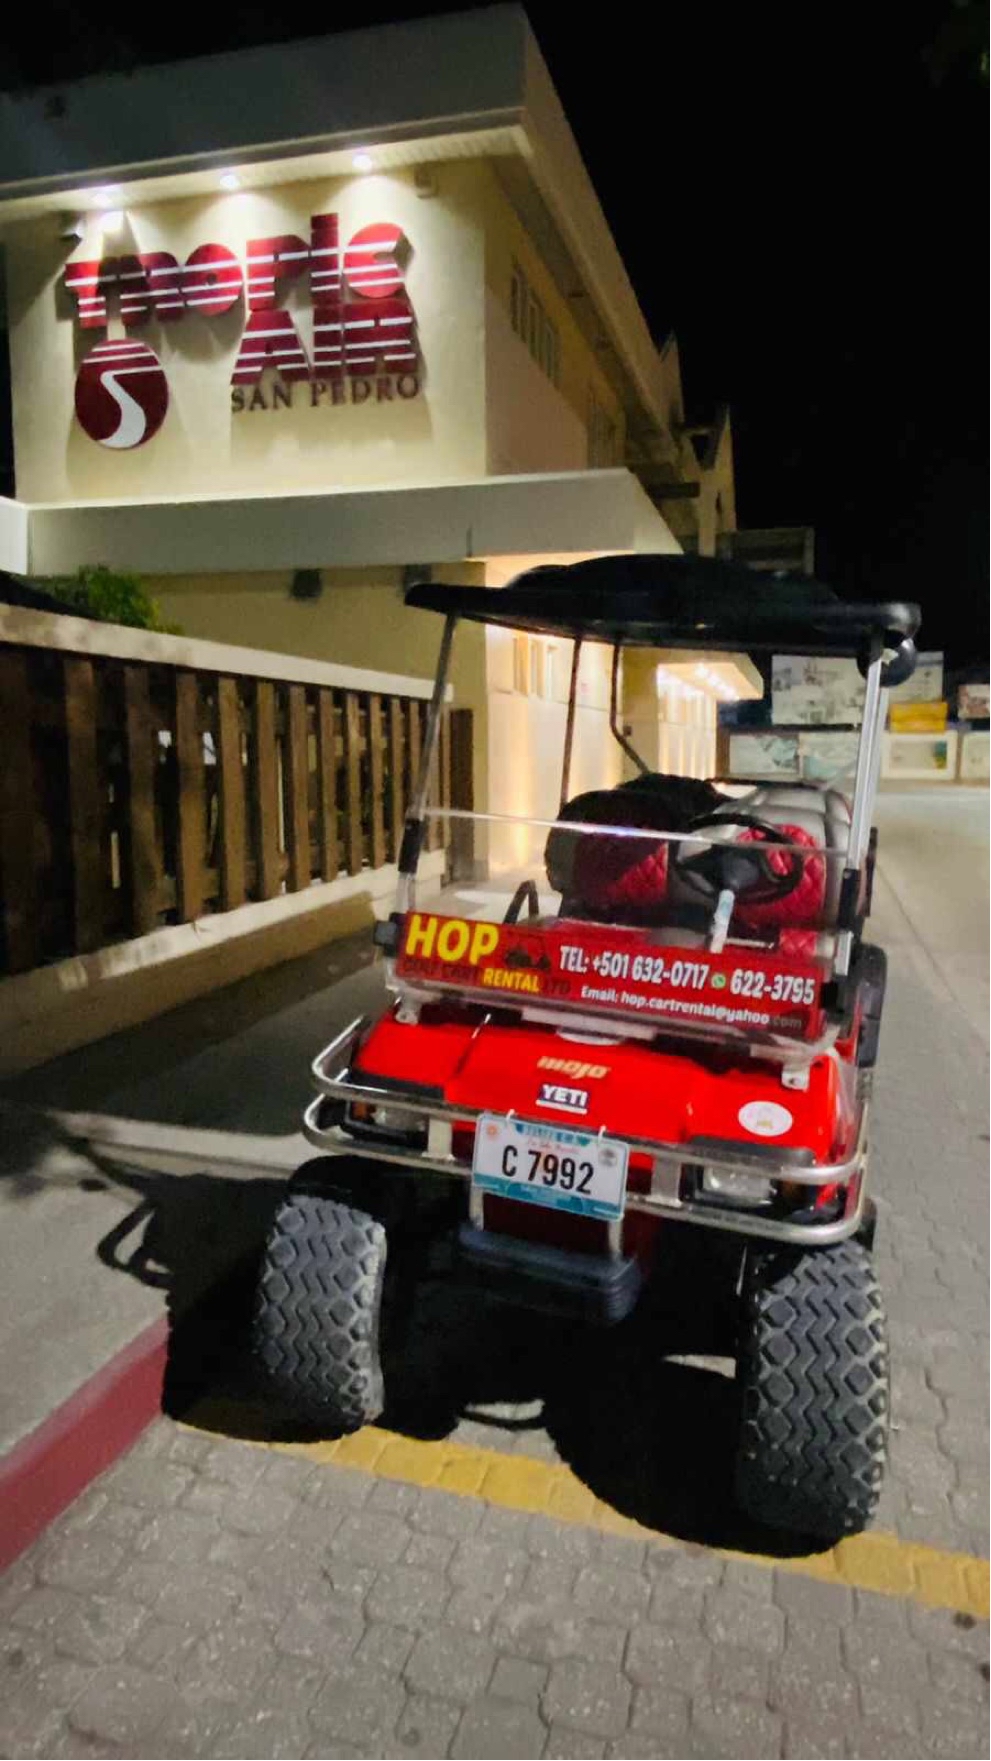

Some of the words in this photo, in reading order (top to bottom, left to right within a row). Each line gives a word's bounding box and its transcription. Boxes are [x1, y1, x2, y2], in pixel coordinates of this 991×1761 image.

[230, 303, 418, 386] AIR
[231, 382, 293, 413] SAN
[310, 374, 419, 407] PEDRO
[405, 915, 499, 964] HOP
[482, 967, 540, 993] RENTAL
[559, 945, 588, 973] TEL:
[592, 951, 629, 979] +501
[632, 955, 710, 991] 632-0717
[730, 968, 815, 1005] 622-3795
[581, 985, 618, 1004] Email:
[542, 1084, 588, 1107] YETI
[502, 1145, 518, 1177] C
[527, 1150, 594, 1195] 7992
